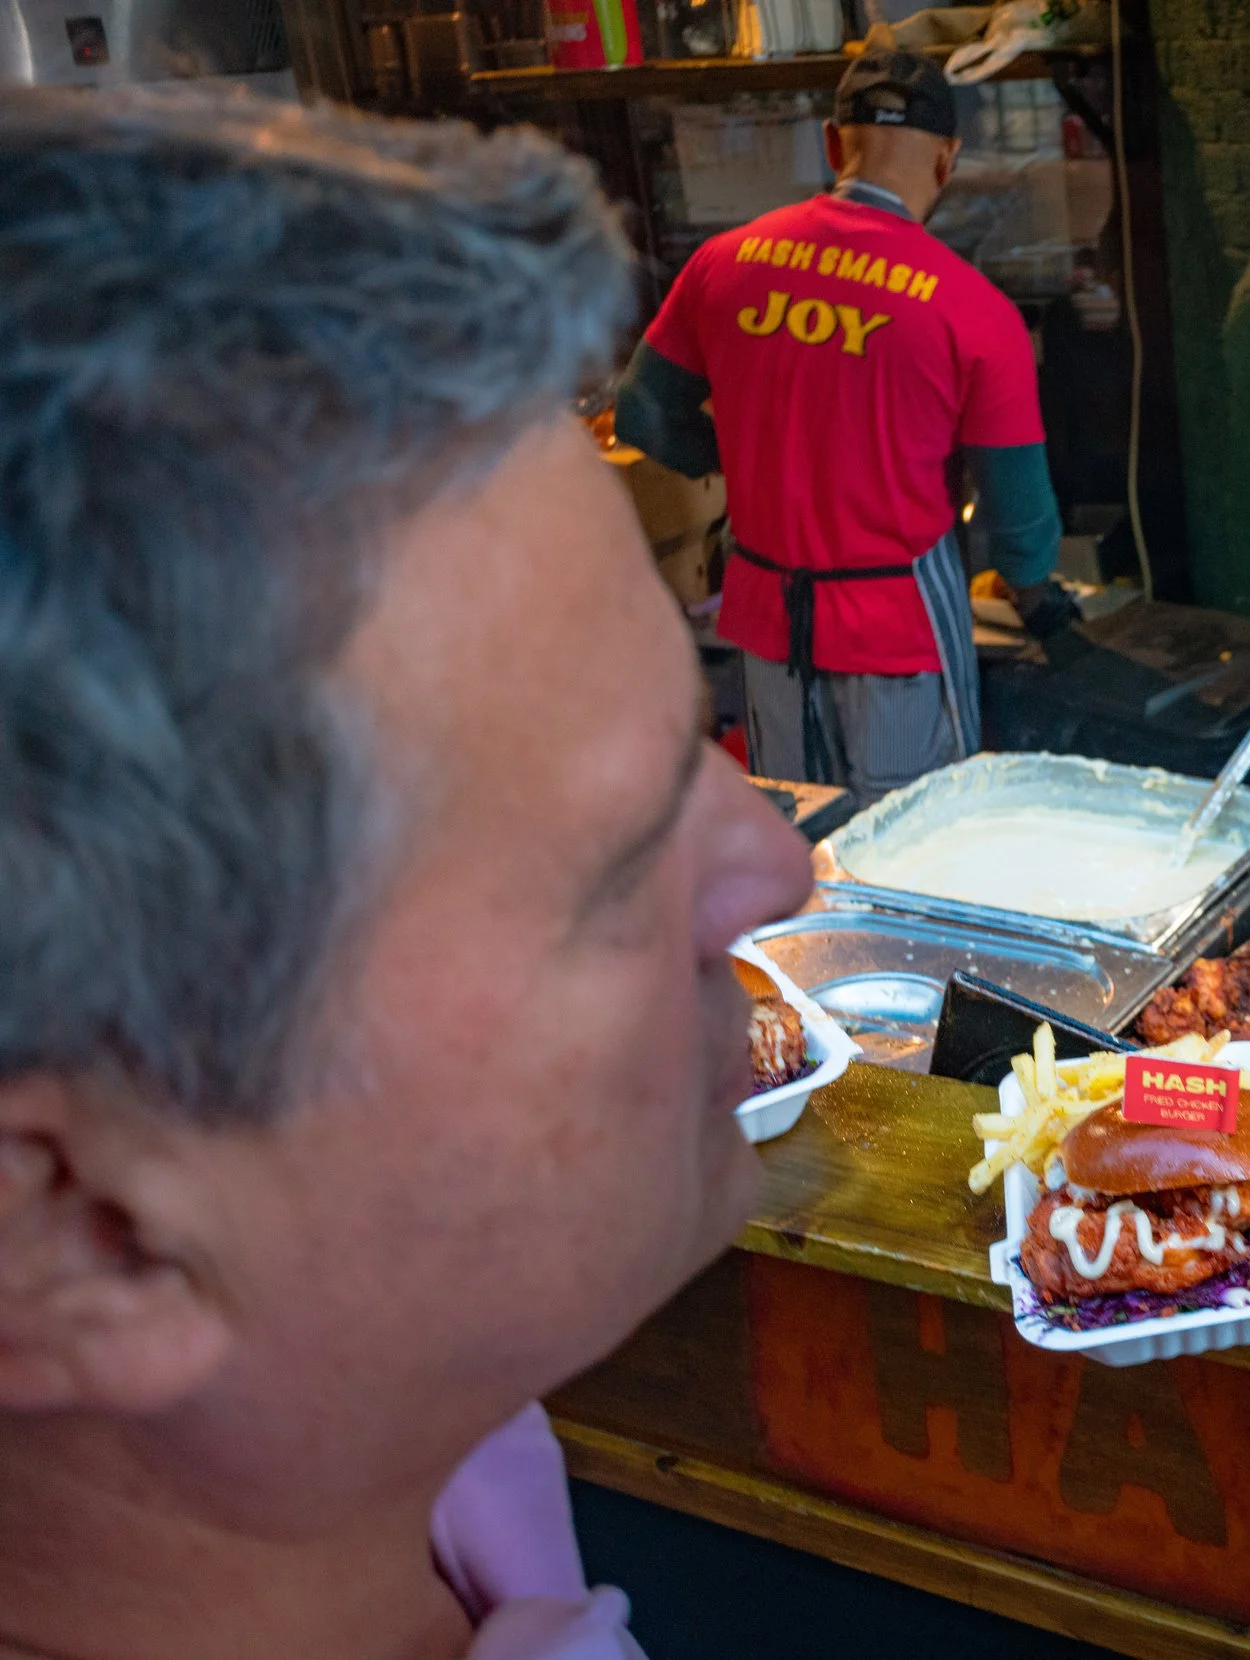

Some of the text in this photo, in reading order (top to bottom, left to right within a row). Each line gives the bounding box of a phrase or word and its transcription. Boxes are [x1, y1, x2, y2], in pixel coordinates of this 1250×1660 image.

[736, 236, 939, 303] HASH SMASH
[736, 290, 892, 356] JOY
[1142, 1070, 1227, 1097] HASH
[1143, 1093, 1224, 1112] FRIED CHICKEN
[1160, 1108, 1206, 1121] BURGER
